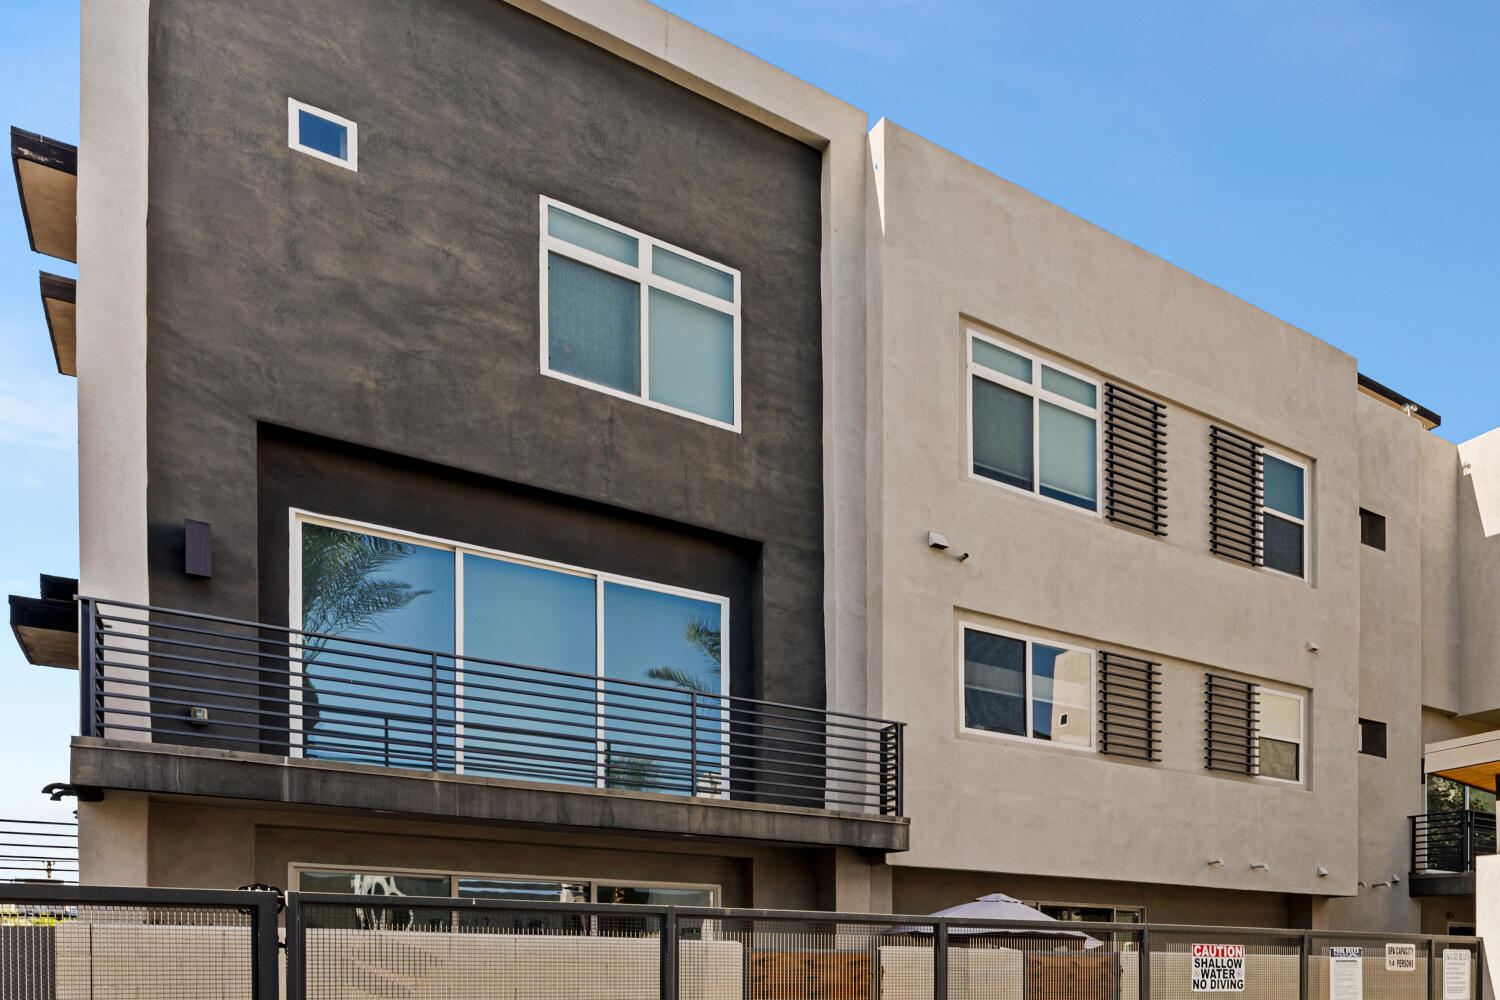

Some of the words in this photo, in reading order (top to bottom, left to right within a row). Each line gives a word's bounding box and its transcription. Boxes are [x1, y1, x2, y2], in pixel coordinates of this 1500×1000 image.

[1194, 945, 1243, 957] CAUTION
[1395, 946, 1414, 956] CAPACITY
[1194, 958, 1242, 968] SHALLOW
[1396, 959, 1414, 968] PERSONS
[1201, 969, 1235, 979] WATER
[1193, 979, 1207, 989] NO
[1210, 979, 1244, 989] DIVING
